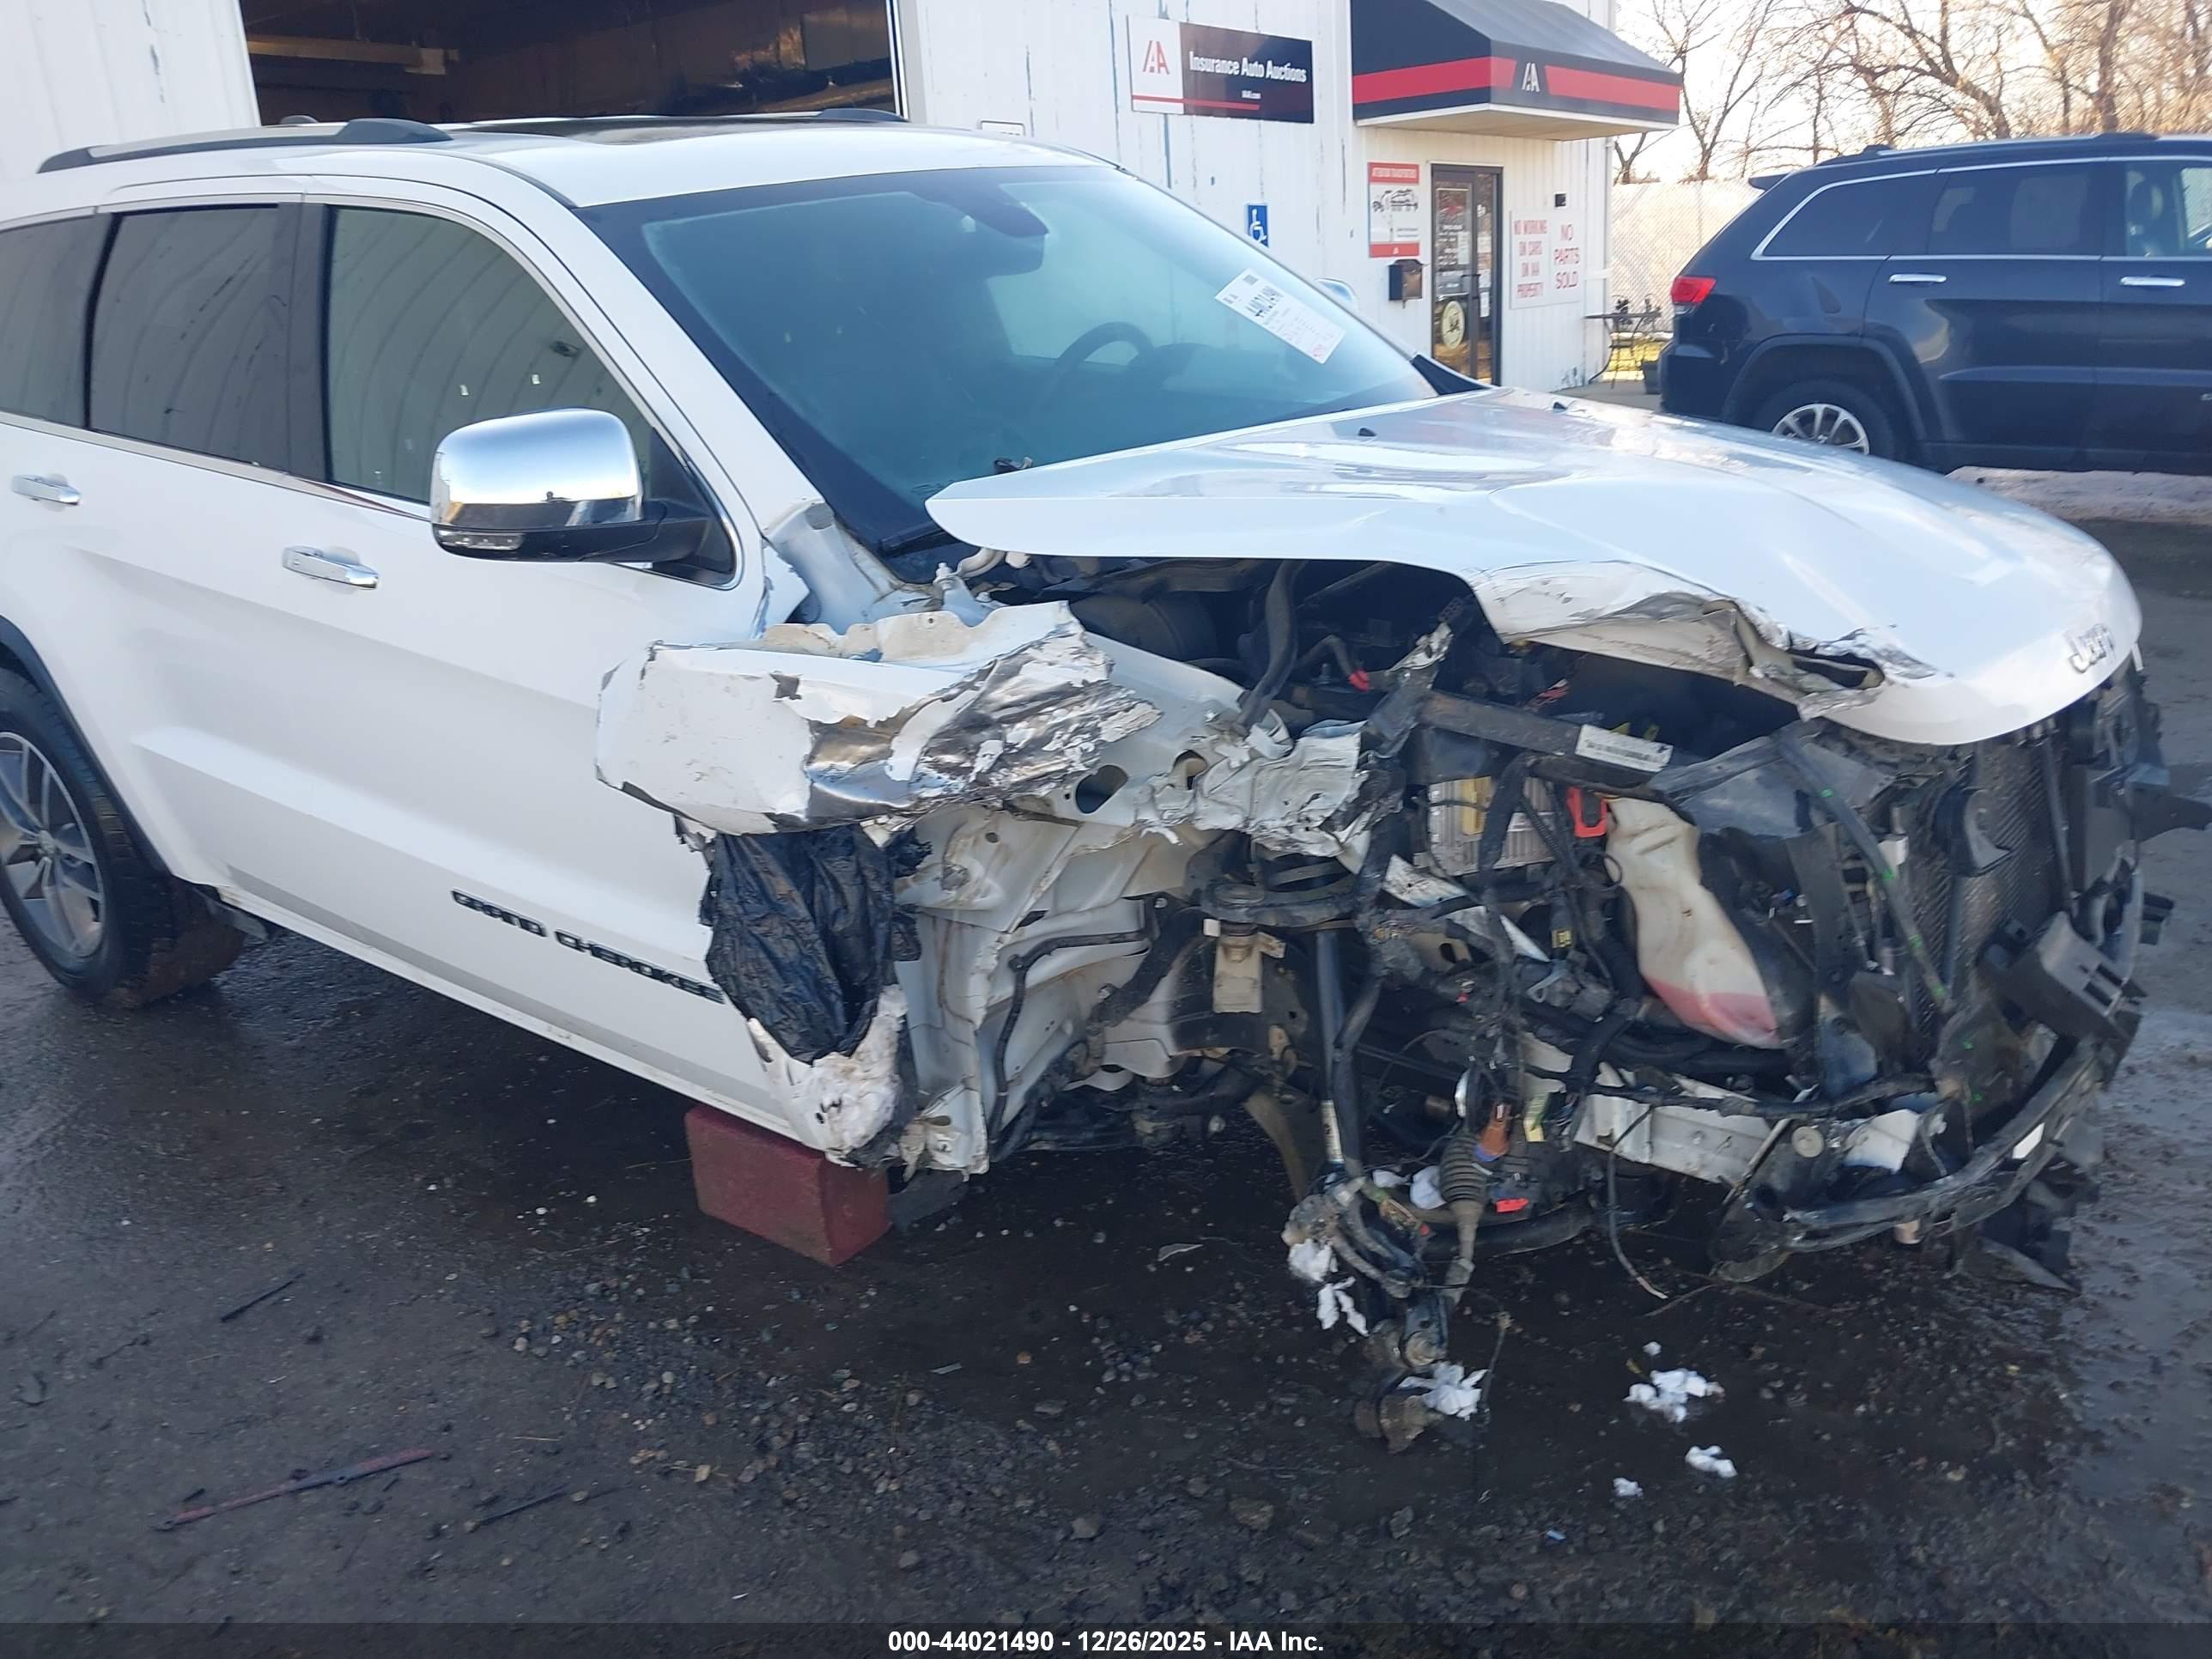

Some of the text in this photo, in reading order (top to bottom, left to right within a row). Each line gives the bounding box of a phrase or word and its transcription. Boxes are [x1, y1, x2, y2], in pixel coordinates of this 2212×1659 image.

[1188, 51, 1307, 83] Insurance Auto Auctions
[1559, 223, 1574, 241] NO
[1553, 247, 1580, 265] PARTS
[1555, 270, 1580, 289] SOLD
